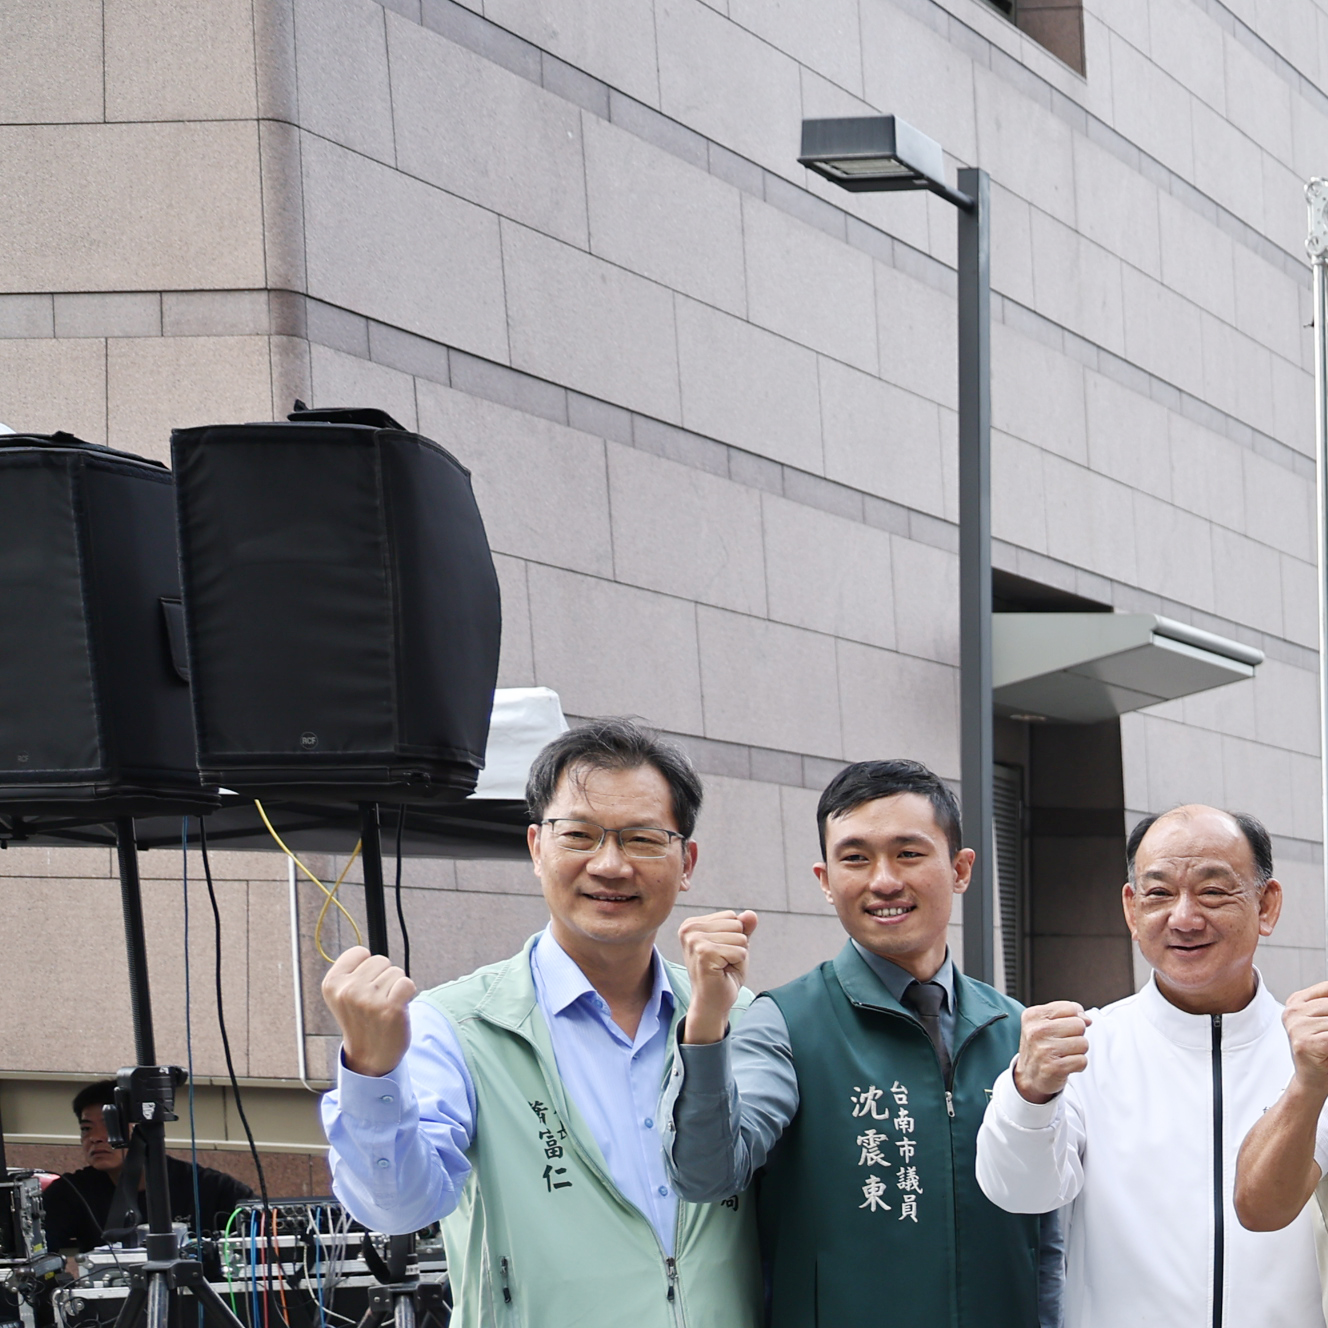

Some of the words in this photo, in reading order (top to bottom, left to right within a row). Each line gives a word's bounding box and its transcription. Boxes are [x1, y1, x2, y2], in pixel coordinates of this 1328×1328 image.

[302, 736, 317, 745] RCF
[851, 1085, 891, 1212] 沈震東
[890, 1081, 923, 1223] 台南市議員
